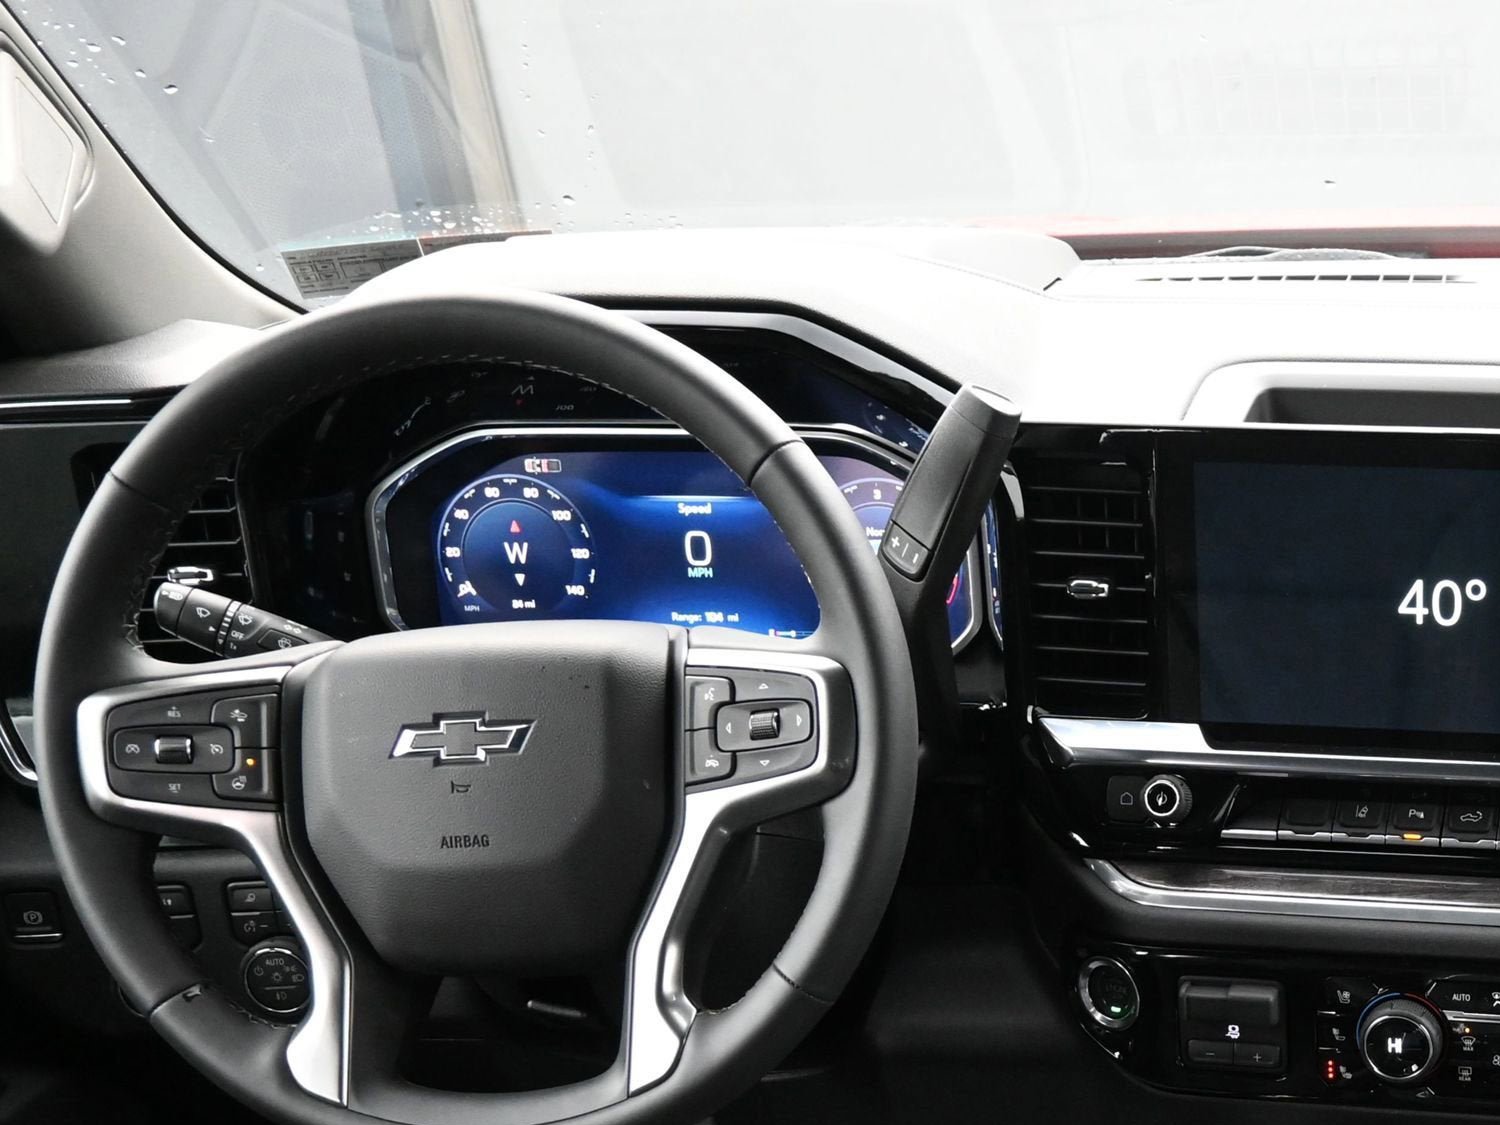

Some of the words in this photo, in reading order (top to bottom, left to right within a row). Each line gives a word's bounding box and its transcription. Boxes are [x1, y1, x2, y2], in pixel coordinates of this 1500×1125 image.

[454, 509, 469, 520] 40
[677, 502, 712, 516] Speed
[552, 510, 572, 521] 100
[866, 527, 885, 537] Nor
[503, 542, 528, 564] W
[684, 530, 712, 567] 0
[688, 567, 713, 578] MPH
[565, 585, 585, 596] 140
[1398, 579, 1487, 627] 40°
[671, 611, 702, 623] Range:
[231, 630, 245, 640] OFF
[167, 710, 181, 718] RES
[168, 783, 181, 791] SET
[440, 834, 490, 849] AIRBAG
[265, 958, 285, 967] AUTO
[1452, 994, 1471, 1002] AUTO
